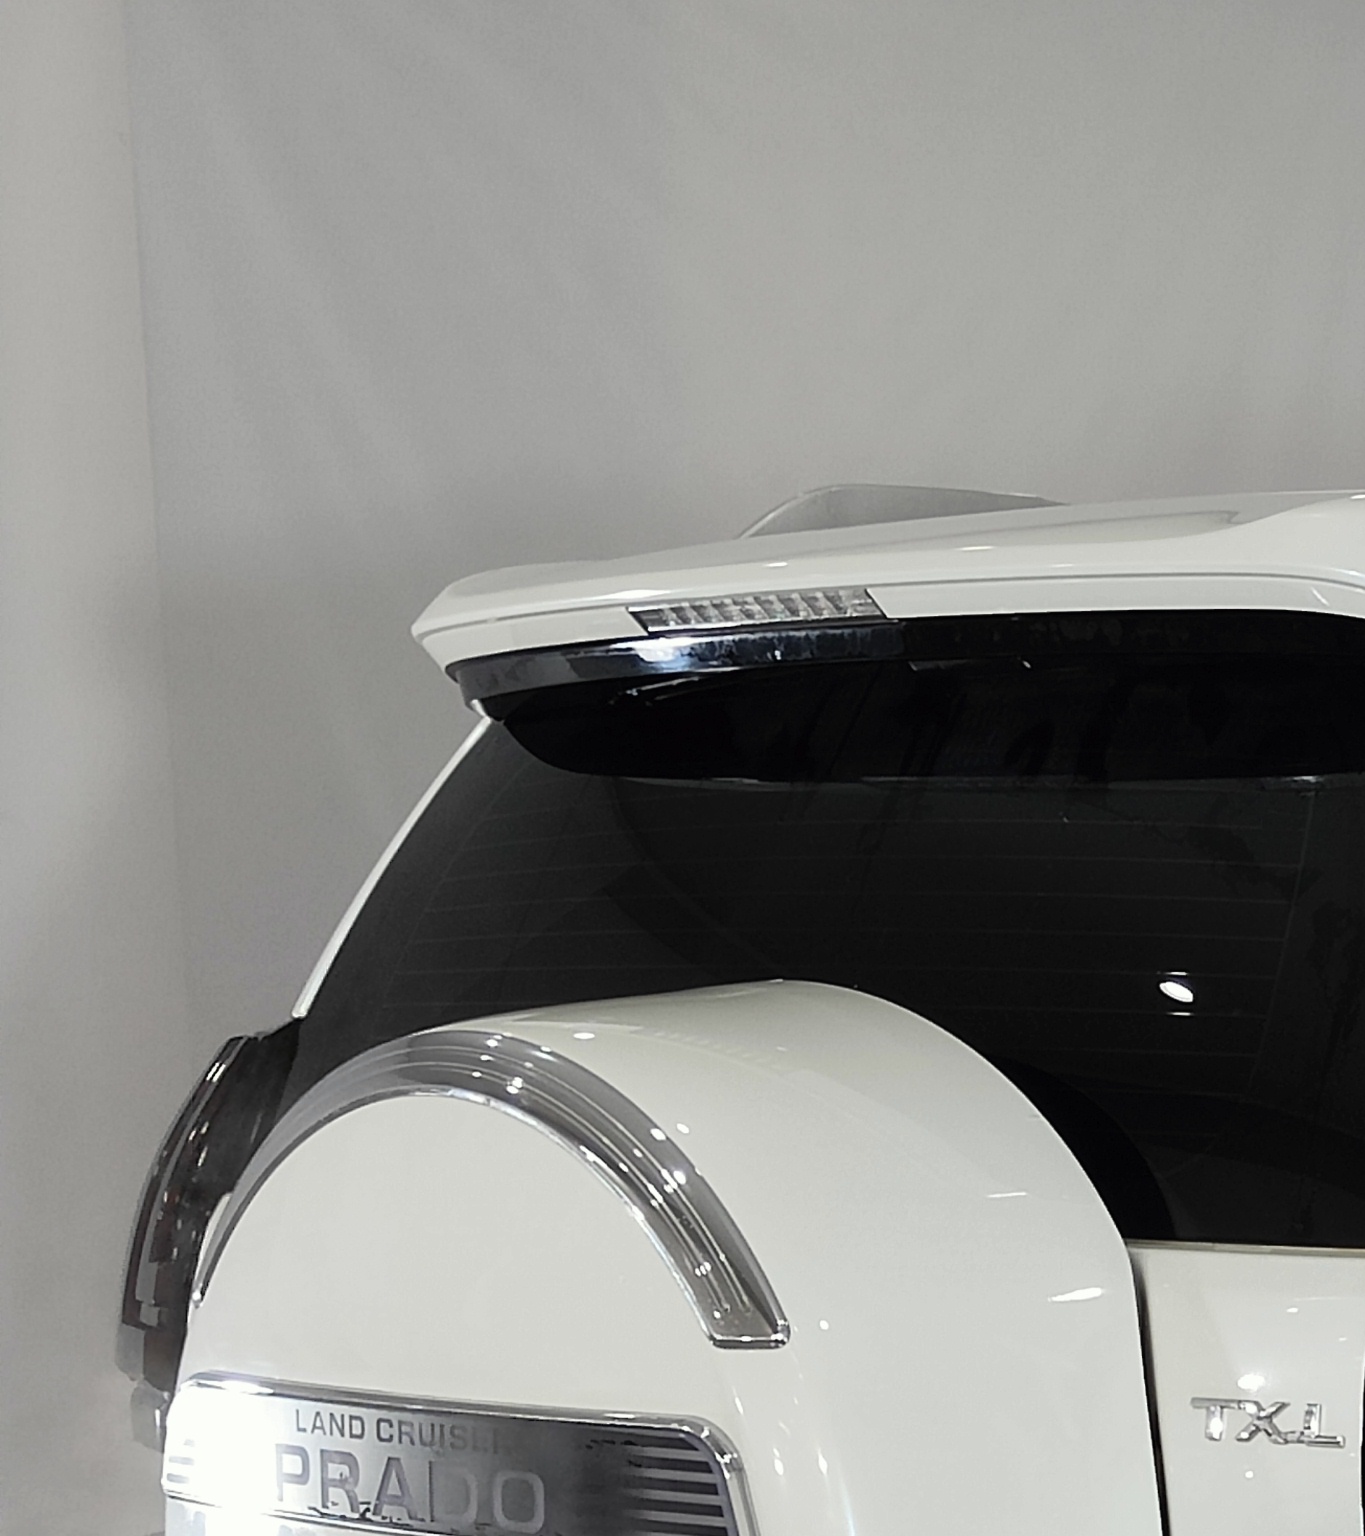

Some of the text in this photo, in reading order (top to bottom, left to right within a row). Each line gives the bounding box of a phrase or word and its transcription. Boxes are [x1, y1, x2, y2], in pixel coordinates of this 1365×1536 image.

[295, 1408, 366, 1440] LAND
[1190, 1396, 1347, 1449] TXL
[275, 1443, 544, 1535] PRADO
